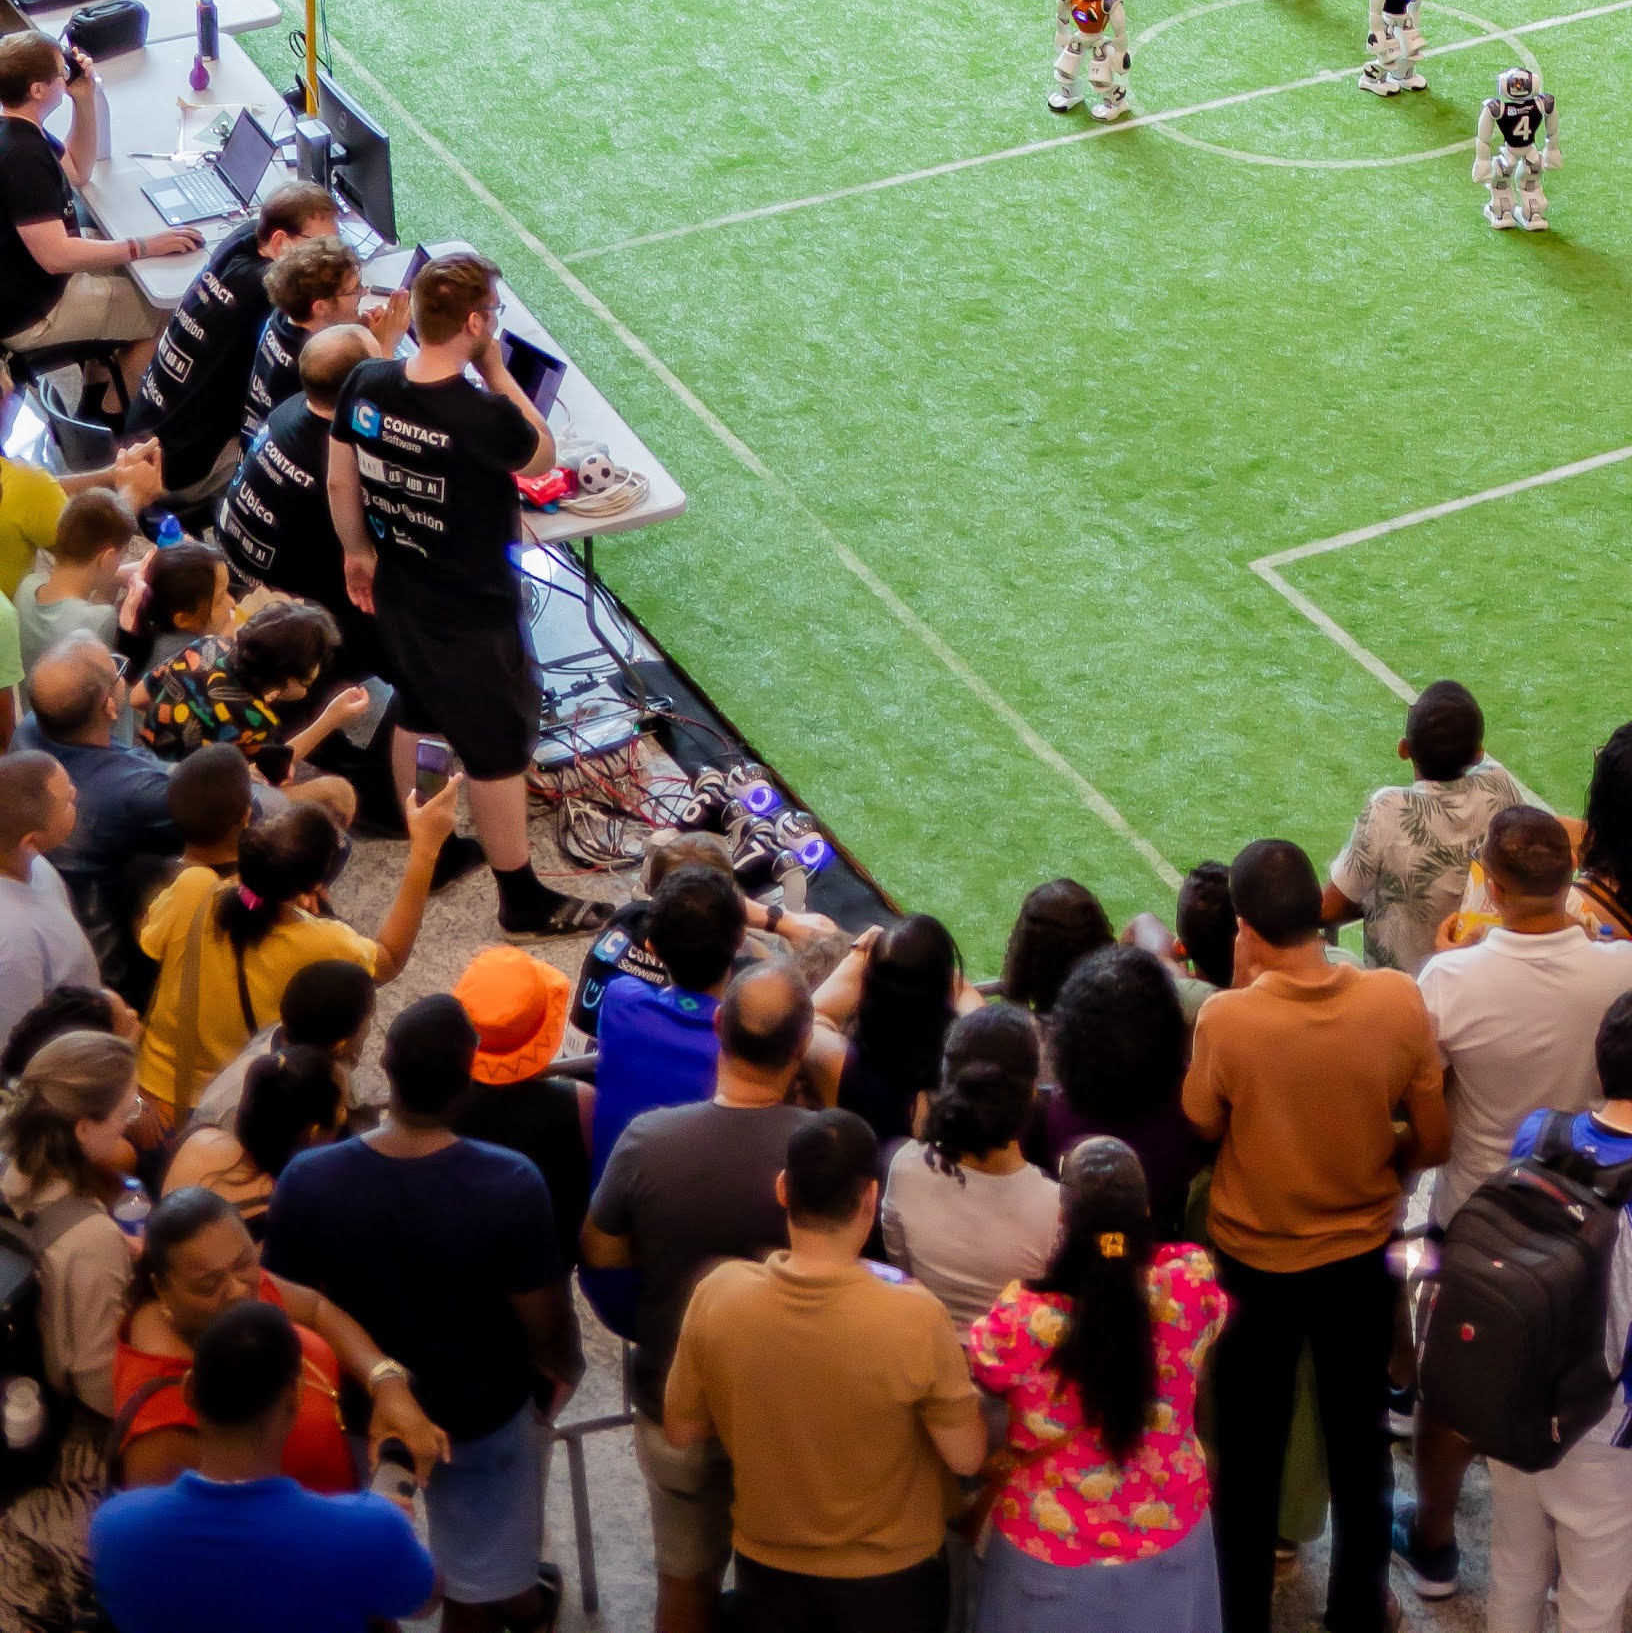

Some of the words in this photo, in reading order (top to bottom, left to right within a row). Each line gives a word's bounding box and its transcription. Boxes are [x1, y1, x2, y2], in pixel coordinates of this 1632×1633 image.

[1512, 115, 1532, 141] 4
[381, 430, 422, 454] Software
[383, 415, 450, 448] CONTACT
[264, 440, 316, 489] CONTACT
[427, 481, 438, 495] AI
[239, 480, 275, 526] Ubica
